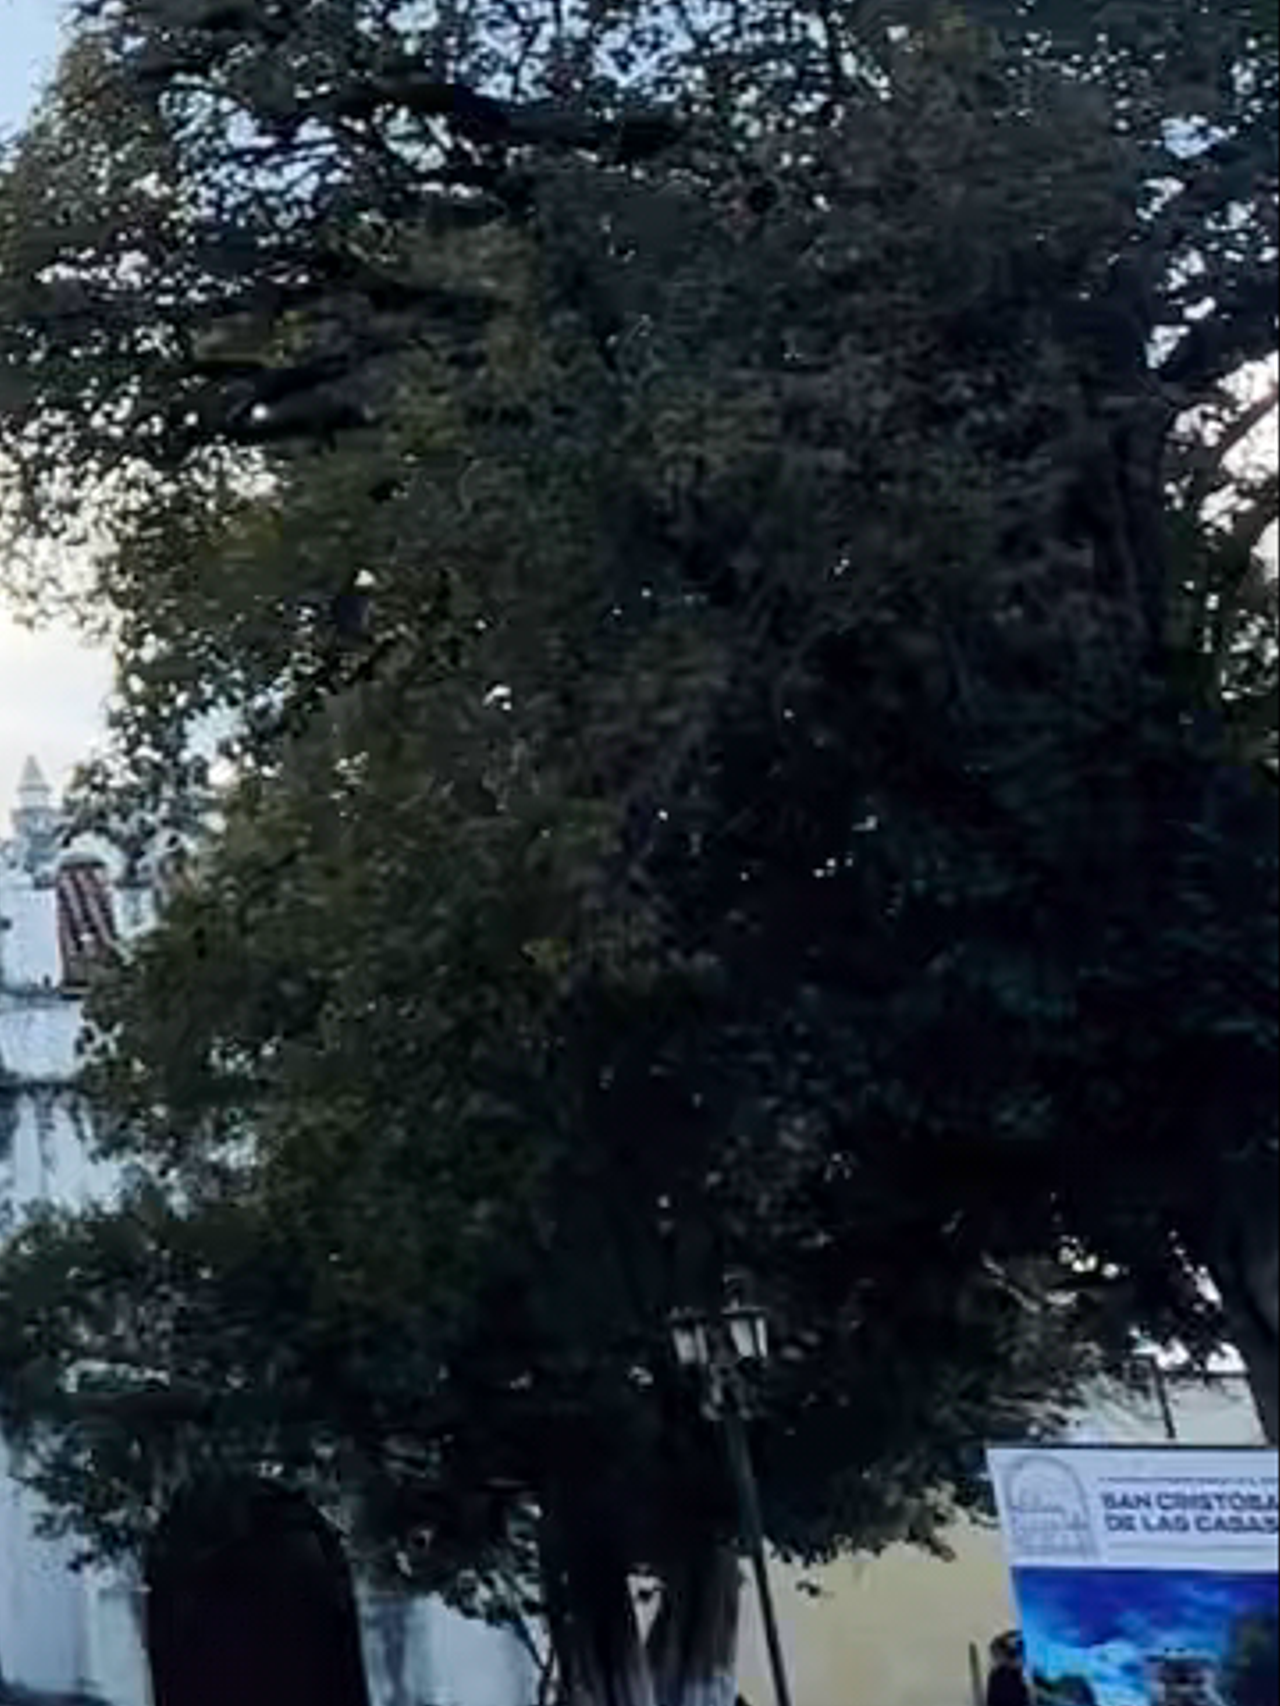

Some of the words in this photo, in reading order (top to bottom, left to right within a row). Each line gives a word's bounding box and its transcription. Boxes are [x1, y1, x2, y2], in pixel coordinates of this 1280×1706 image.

[1101, 1491, 1152, 1509] SAN
[1105, 1515, 1136, 1531] DE
[1142, 1515, 1190, 1532] LAS
